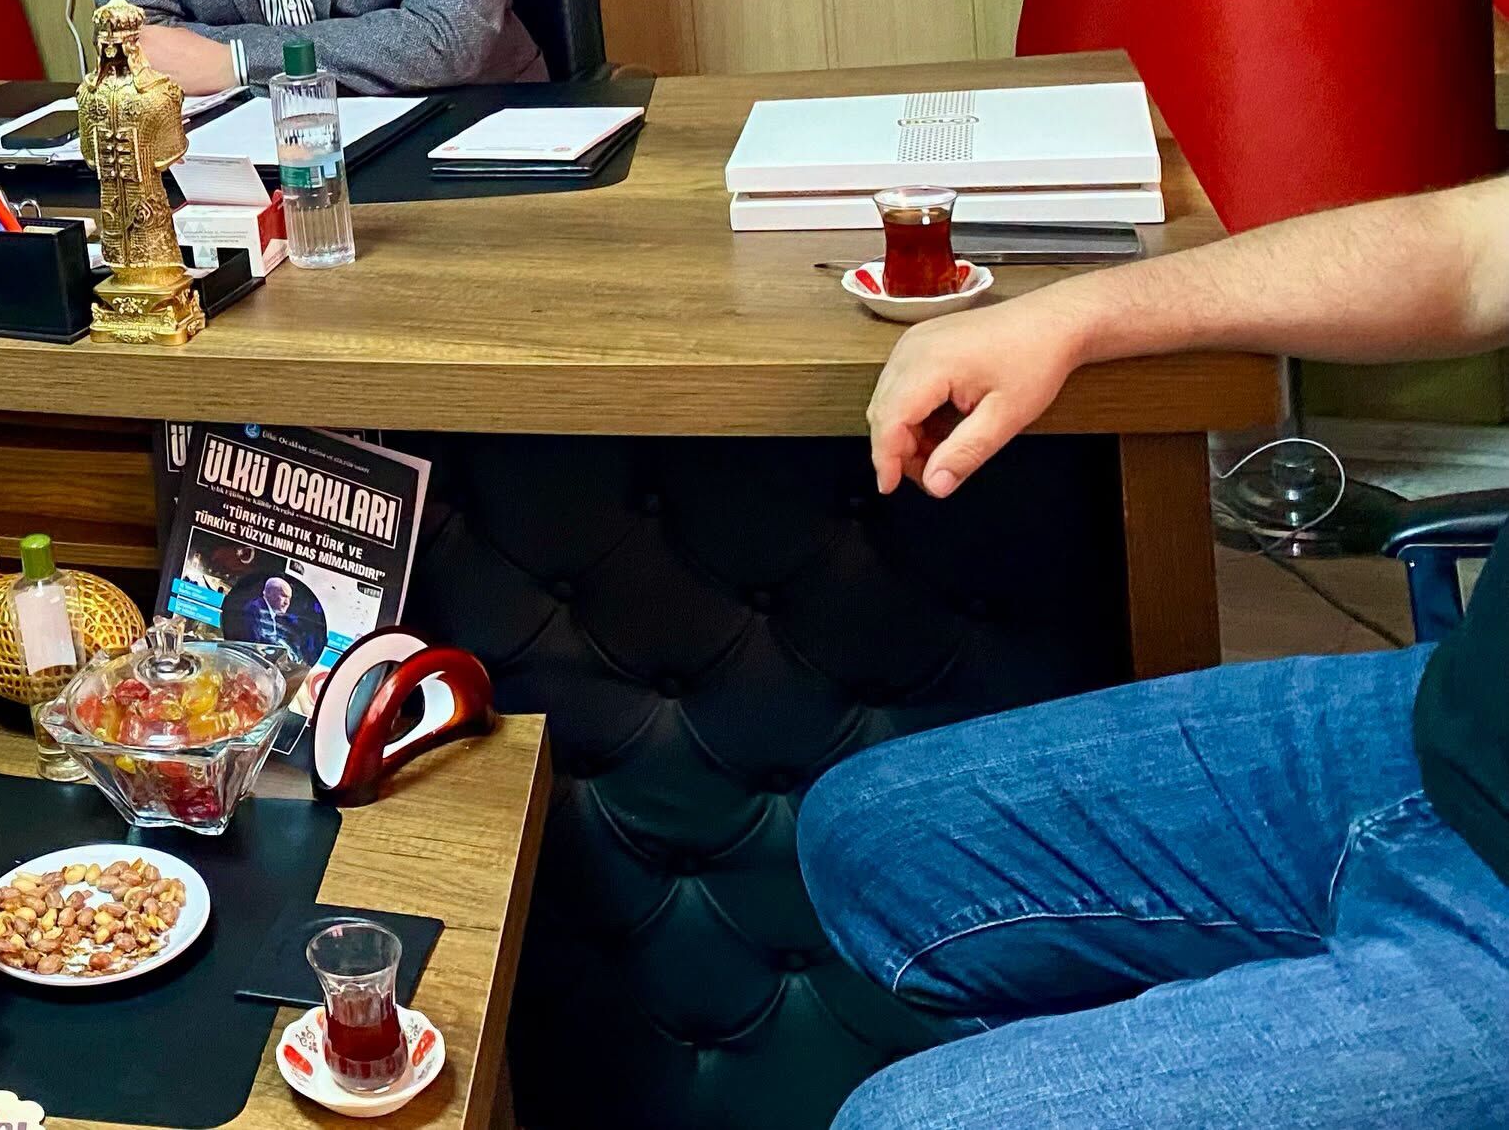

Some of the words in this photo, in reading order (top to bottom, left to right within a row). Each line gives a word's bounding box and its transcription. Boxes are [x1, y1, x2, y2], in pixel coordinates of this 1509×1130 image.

[204, 439, 270, 497] ÜLKÜ
[272, 461, 397, 541] OCAKLARI
[195, 509, 237, 535] TÜRKİYE
[239, 525, 293, 552] YÜZYILININ
[295, 544, 317, 562] BAŞ
[278, 519, 311, 542] ARTIK
[315, 533, 343, 554] TÜRK
[348, 545, 363, 560] VE
